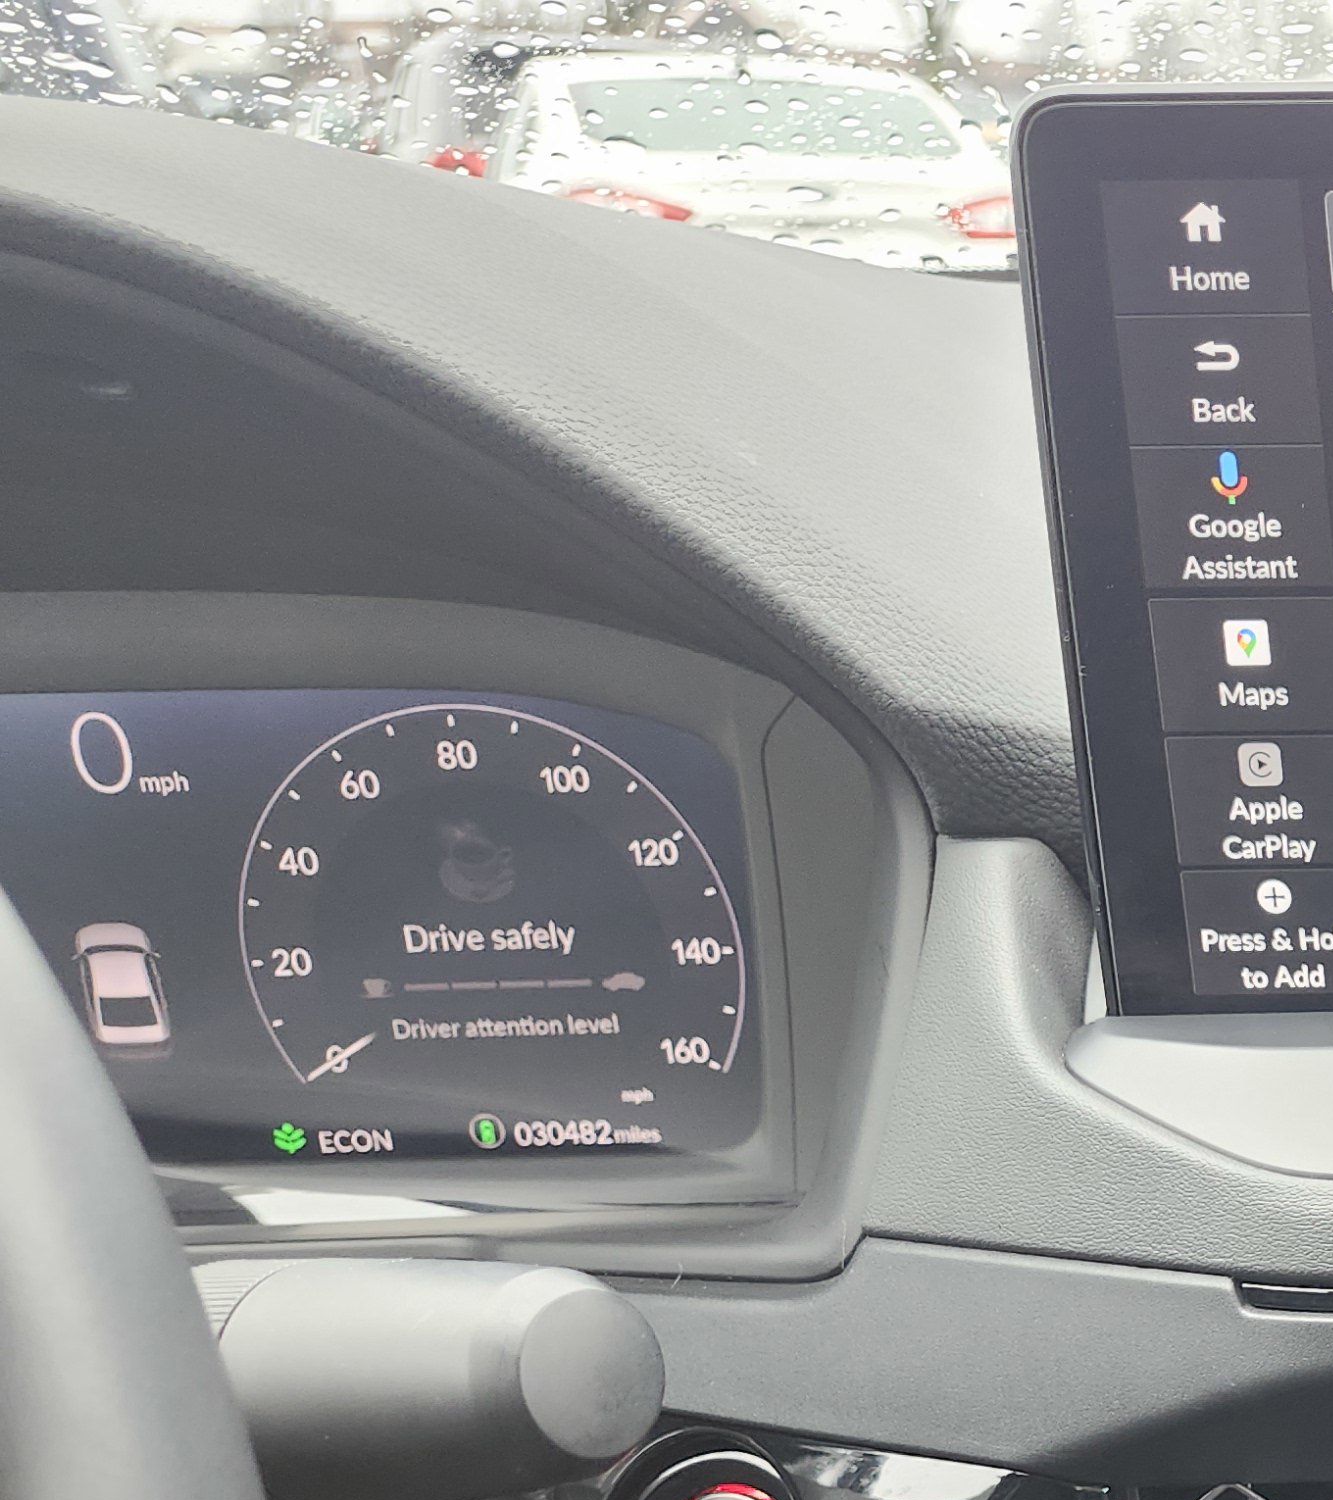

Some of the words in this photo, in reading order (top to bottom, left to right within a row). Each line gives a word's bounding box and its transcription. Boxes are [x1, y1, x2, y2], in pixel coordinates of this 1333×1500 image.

[1170, 266, 1250, 291] Home
[1192, 398, 1256, 423] Back
[1188, 513, 1282, 541] Google
[1182, 555, 1298, 581] Assistant
[1218, 682, 1289, 709] Maps
[71, 711, 133, 794] 0
[139, 770, 190, 796] mph
[437, 740, 478, 771] 80
[340, 769, 380, 800] 60
[539, 764, 591, 794] 100
[1229, 797, 1304, 825] Apple
[279, 846, 319, 876] 40
[627, 837, 679, 868] 120
[1222, 836, 1317, 863] CarPlay
[402, 924, 485, 954] Drive
[491, 920, 576, 955] safely
[1201, 928, 1266, 954] Press
[1271, 928, 1294, 952] &
[271, 947, 312, 977] 20
[671, 937, 721, 967] 140
[1241, 966, 1270, 990] to
[1274, 964, 1325, 989] Add
[391, 1018, 459, 1041] Driver
[465, 1015, 564, 1039] attention
[567, 1013, 621, 1035] level
[660, 1036, 710, 1065] 160
[318, 1128, 395, 1155] ECON
[513, 1119, 614, 1147] 030482
[614, 1124, 663, 1145] miles
